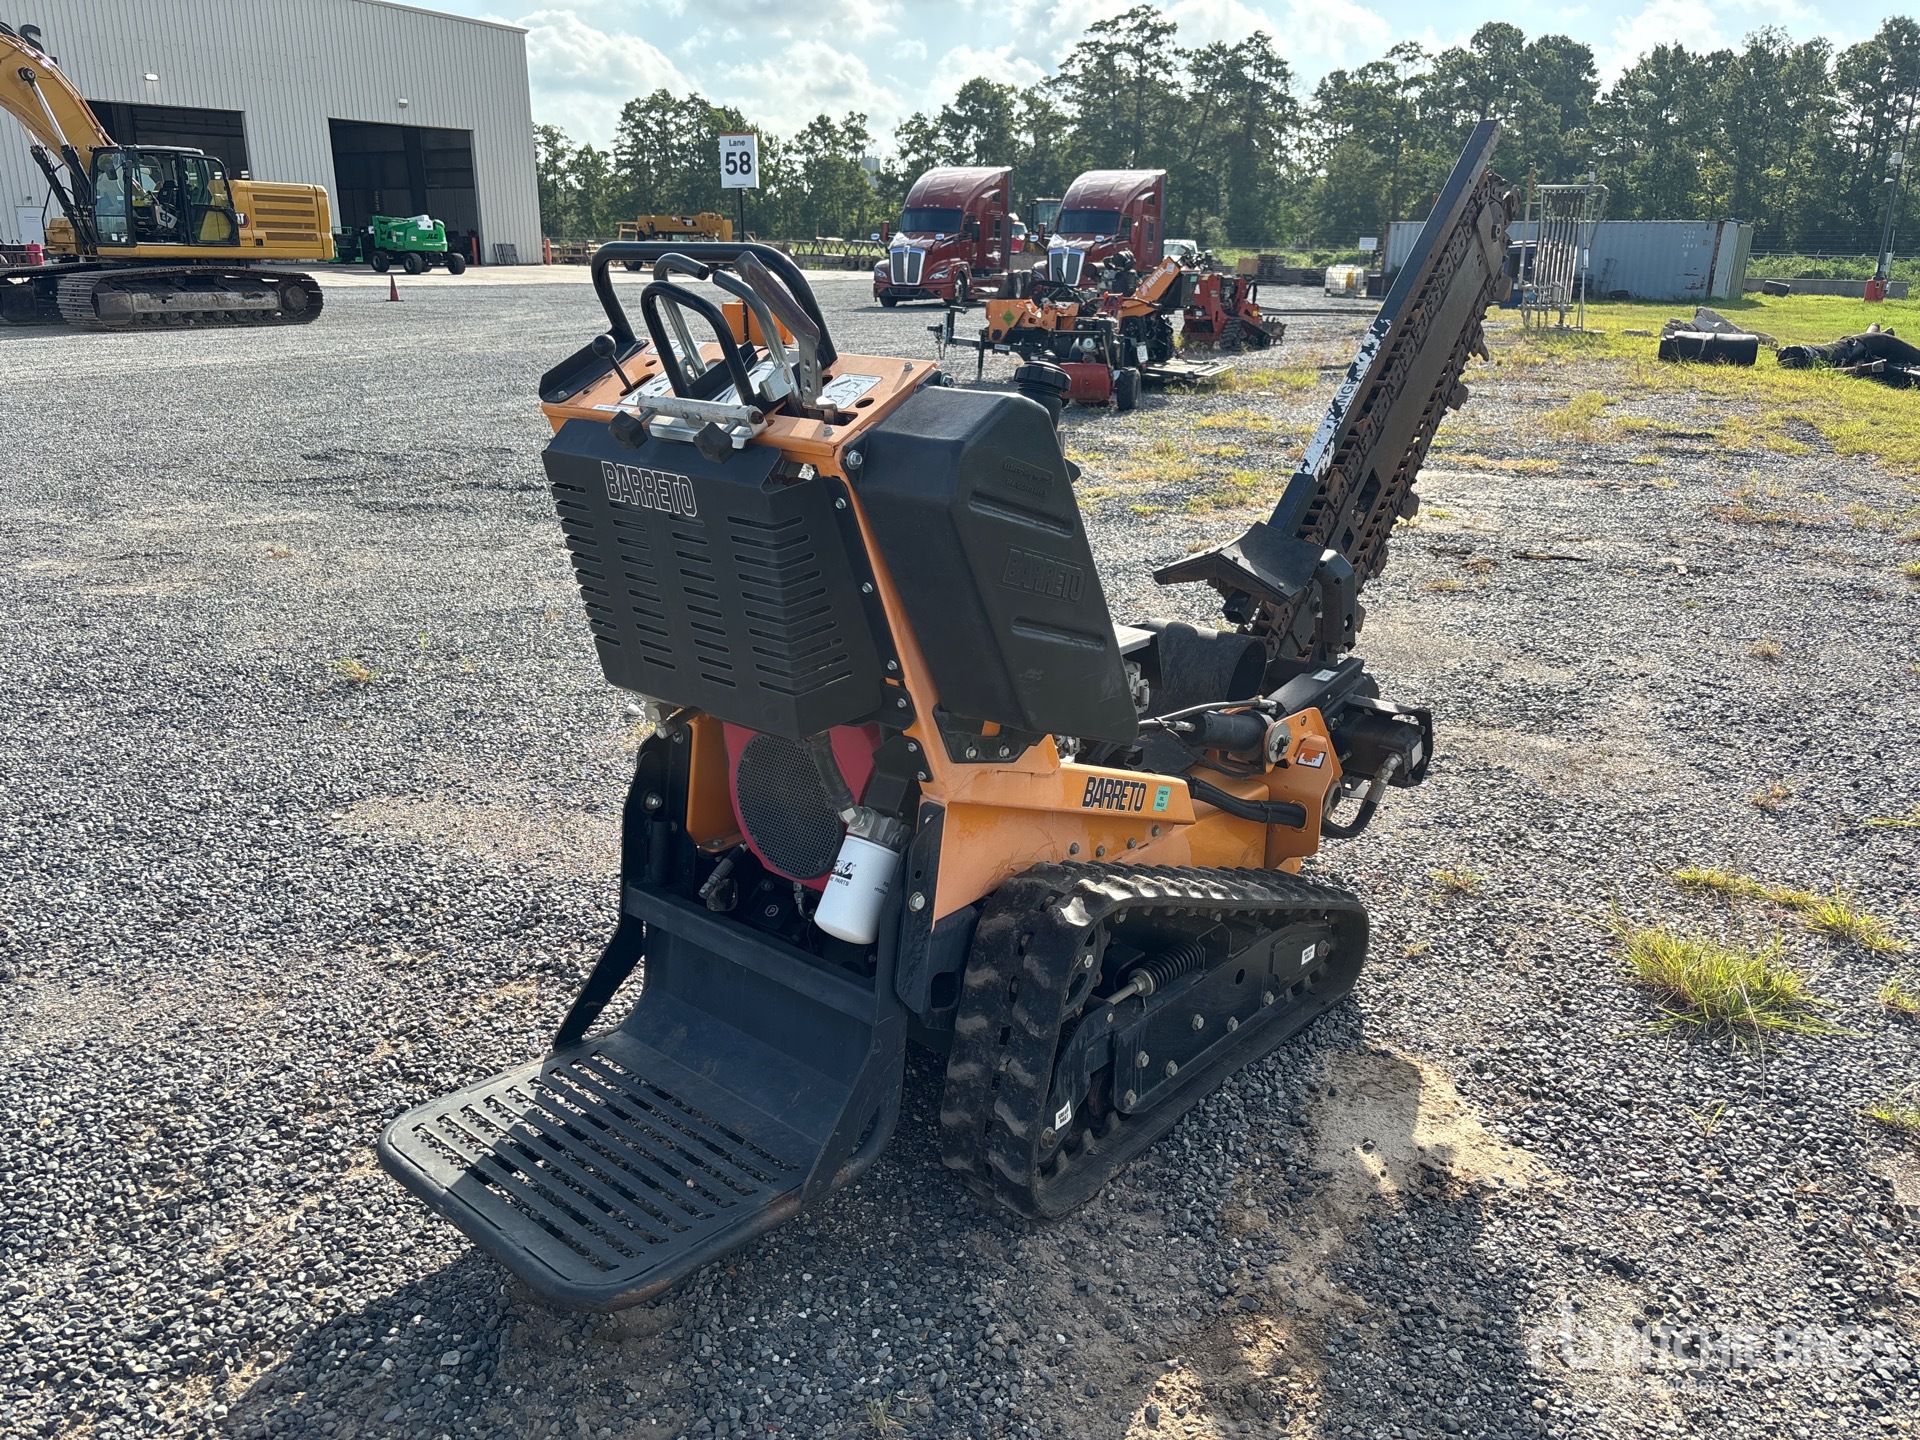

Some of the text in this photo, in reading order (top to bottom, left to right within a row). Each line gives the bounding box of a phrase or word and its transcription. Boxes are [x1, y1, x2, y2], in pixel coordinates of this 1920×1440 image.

[728, 139, 746, 147] Lane
[725, 151, 752, 175] 58
[1145, 266, 1167, 288] RENTAL
[601, 461, 697, 517] BARRETO
[1003, 548, 1084, 601] BARRETO
[1081, 776, 1146, 812] BARRETO
[835, 877, 849, 887] PARTS
